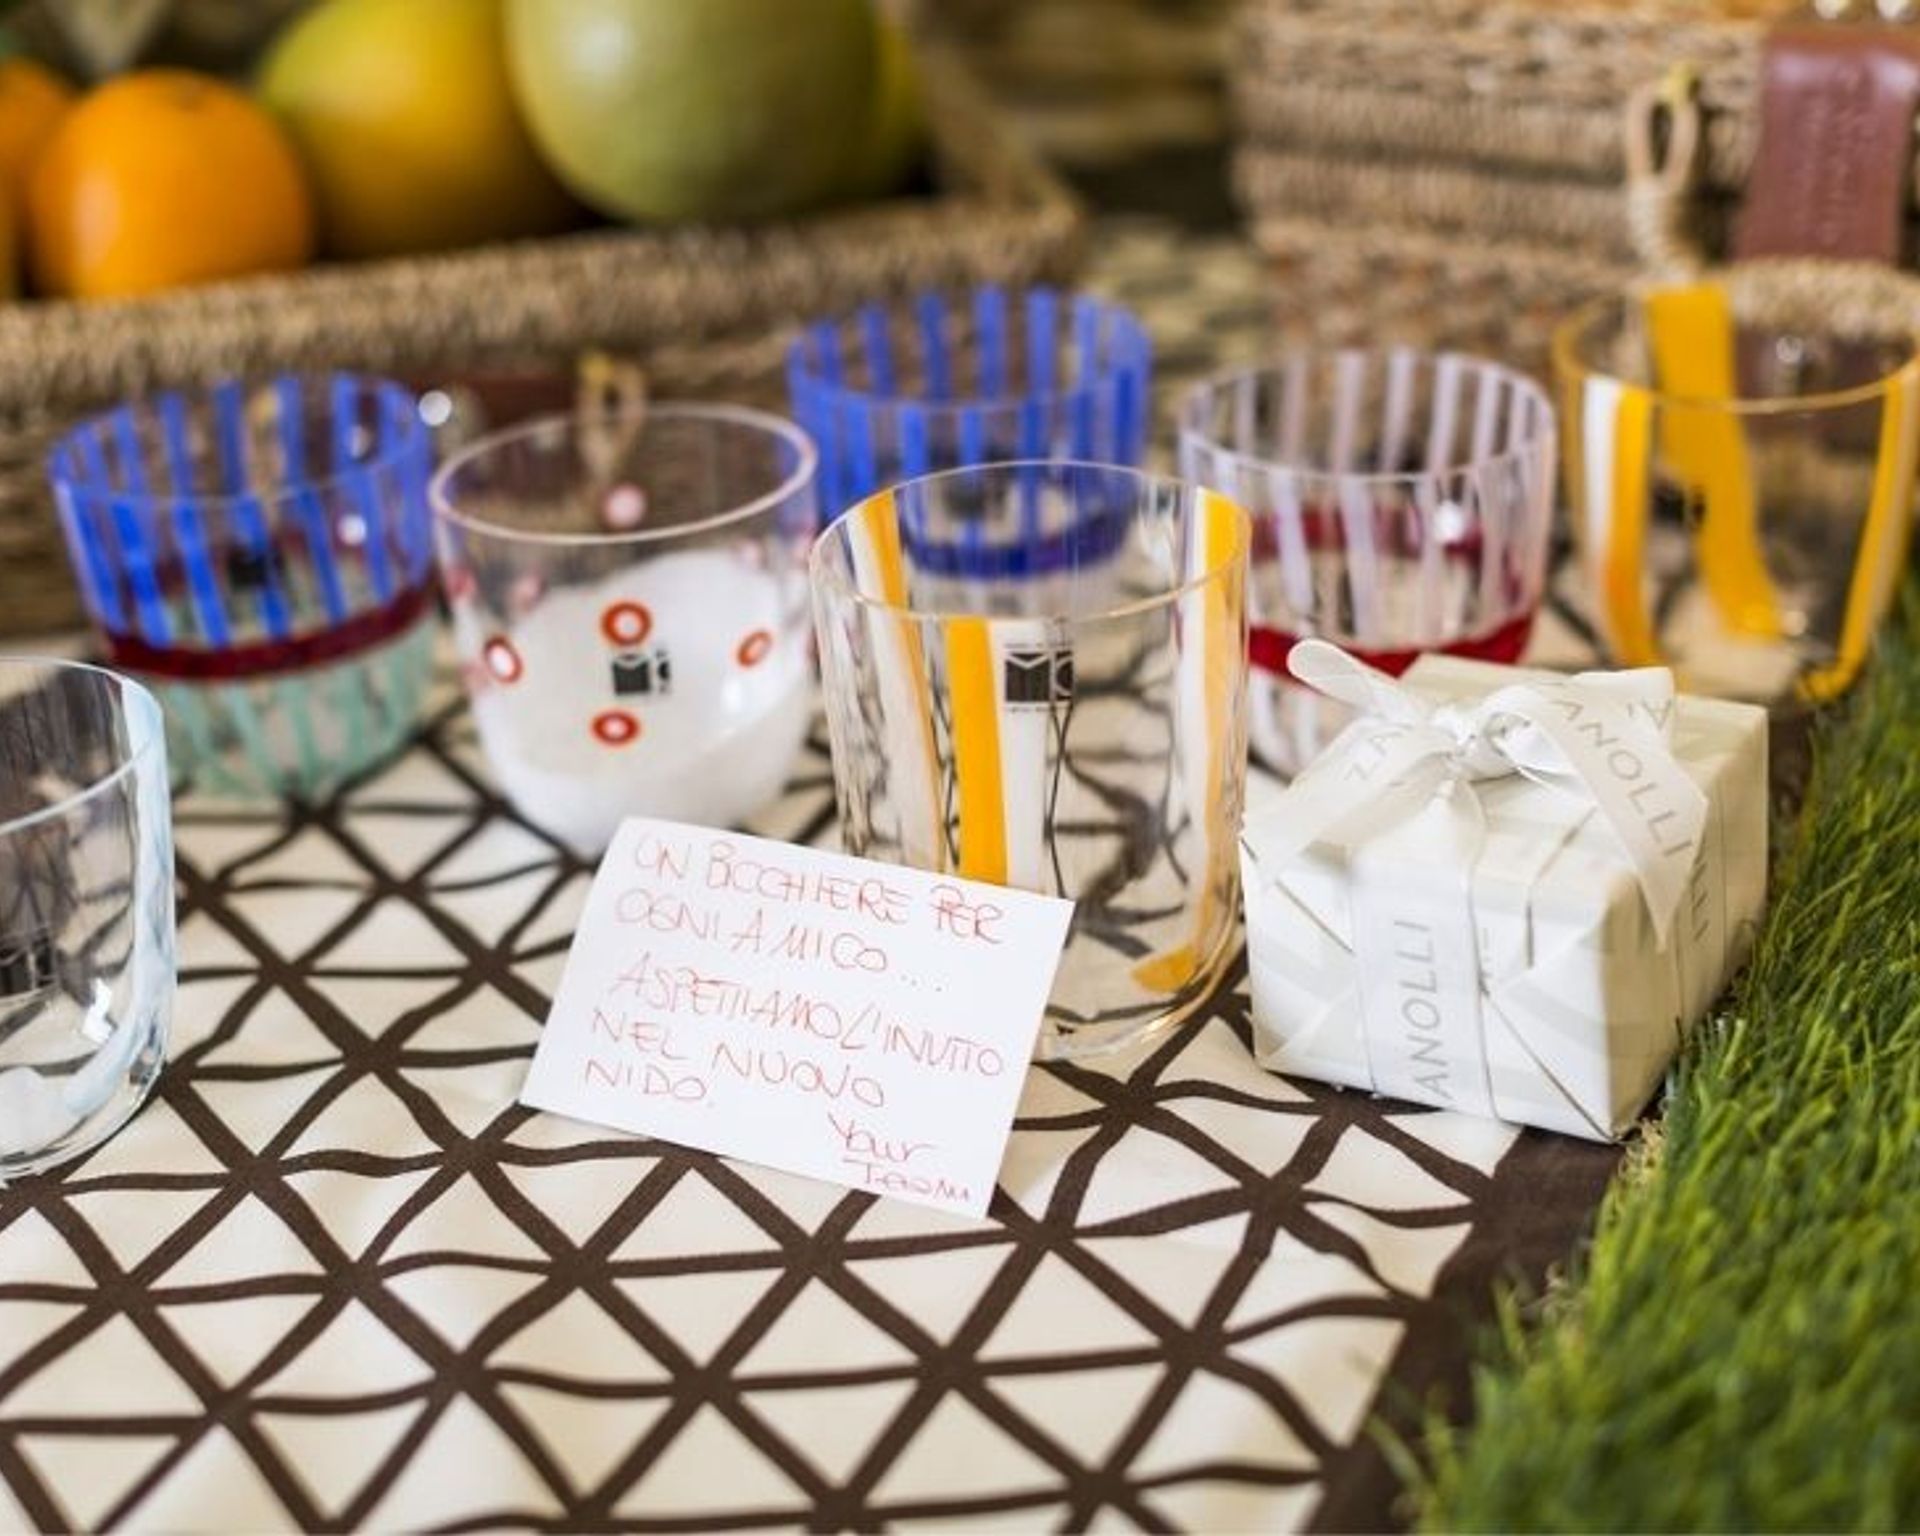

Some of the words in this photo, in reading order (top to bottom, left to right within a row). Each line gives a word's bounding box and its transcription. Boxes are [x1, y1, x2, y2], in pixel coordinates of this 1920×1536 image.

[616, 888, 720, 941] OGNI
[636, 834, 692, 880] UN
[930, 884, 1004, 943] PER
[593, 1006, 690, 1060] NEL
[711, 1042, 885, 1108] NUOVO
[1393, 918, 1452, 1099] ANOLLI
